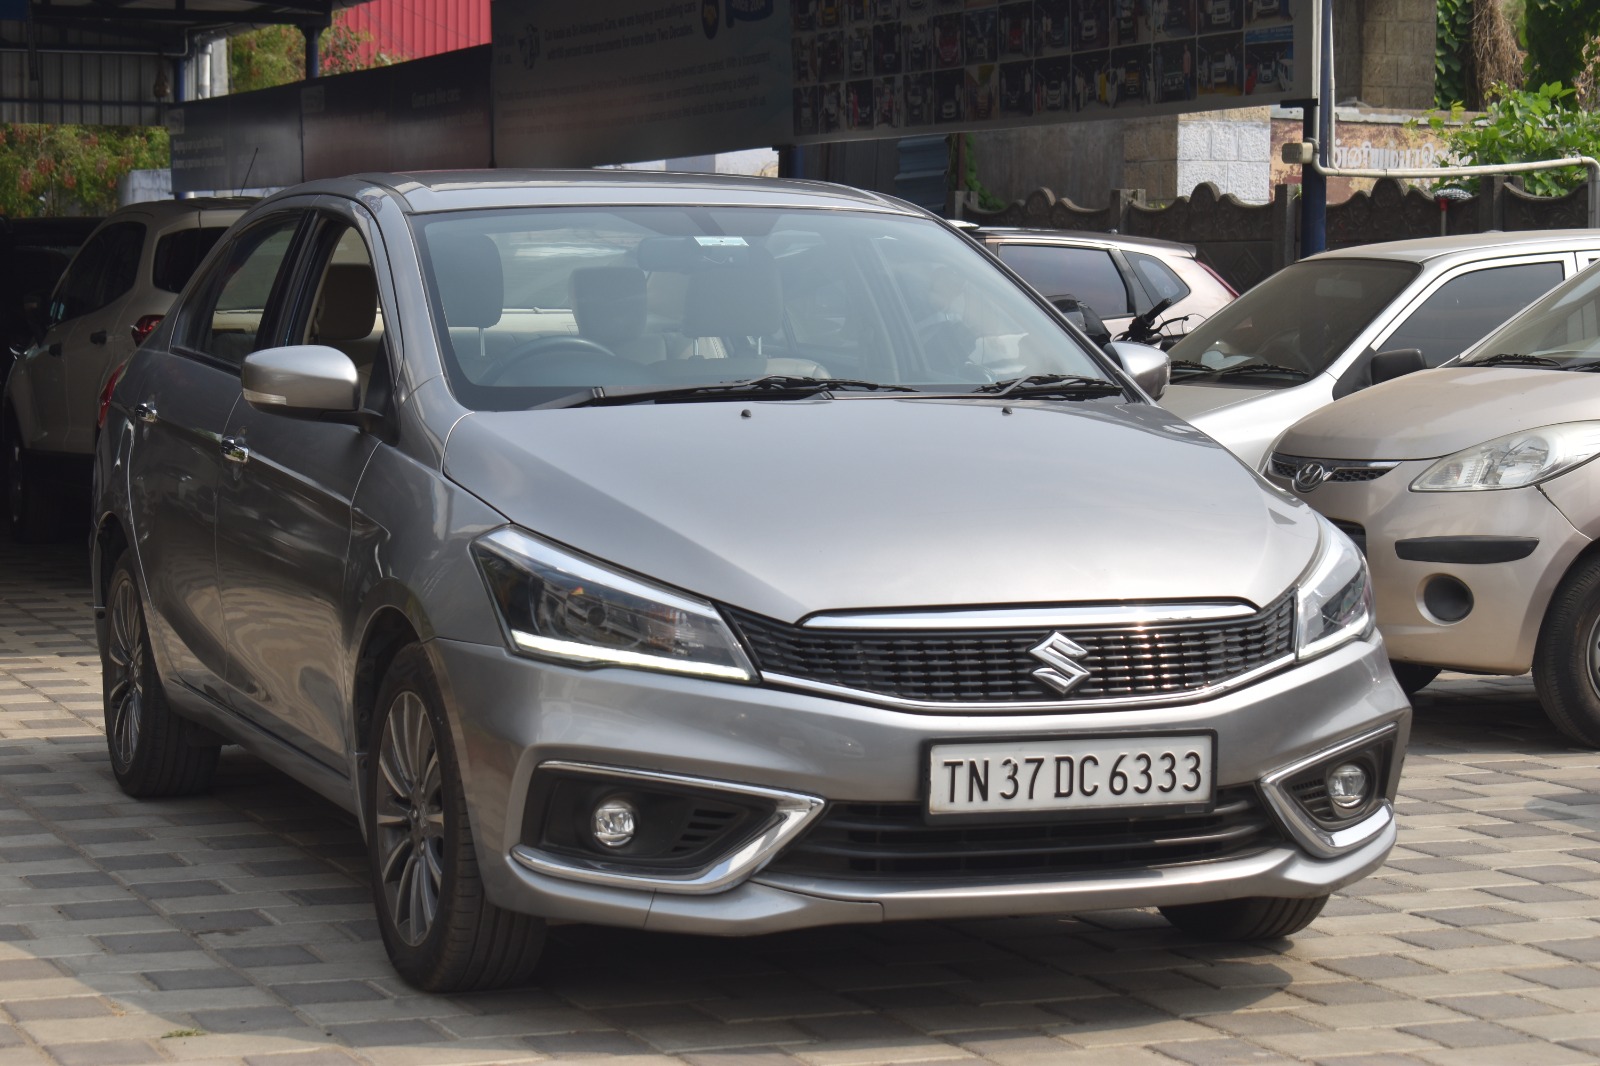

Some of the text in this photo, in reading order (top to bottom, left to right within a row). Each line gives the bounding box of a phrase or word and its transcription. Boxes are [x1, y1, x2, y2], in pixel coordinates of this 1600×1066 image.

[942, 751, 1203, 803] TN 37 DC 6333
